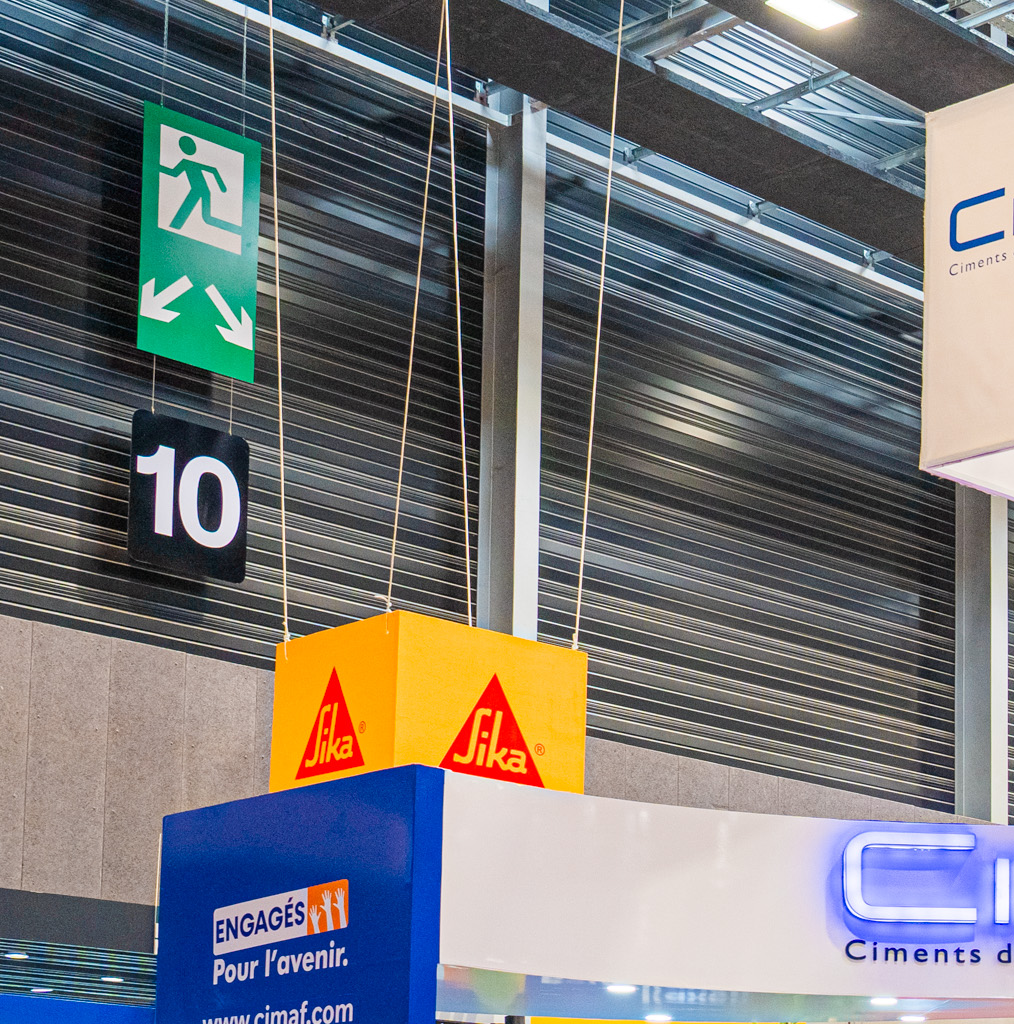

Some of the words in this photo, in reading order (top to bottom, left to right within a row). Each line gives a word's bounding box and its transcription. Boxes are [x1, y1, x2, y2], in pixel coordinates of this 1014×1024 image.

[949, 251, 1007, 277] Ciments
[136, 445, 241, 549] 10
[305, 702, 353, 768] Sika
[453, 708, 528, 775] Sika
[215, 897, 305, 944] ENGAGÉS
[212, 957, 259, 986] Pour
[264, 940, 349, 978] l'avenir.
[844, 938, 982, 965] Ciments
